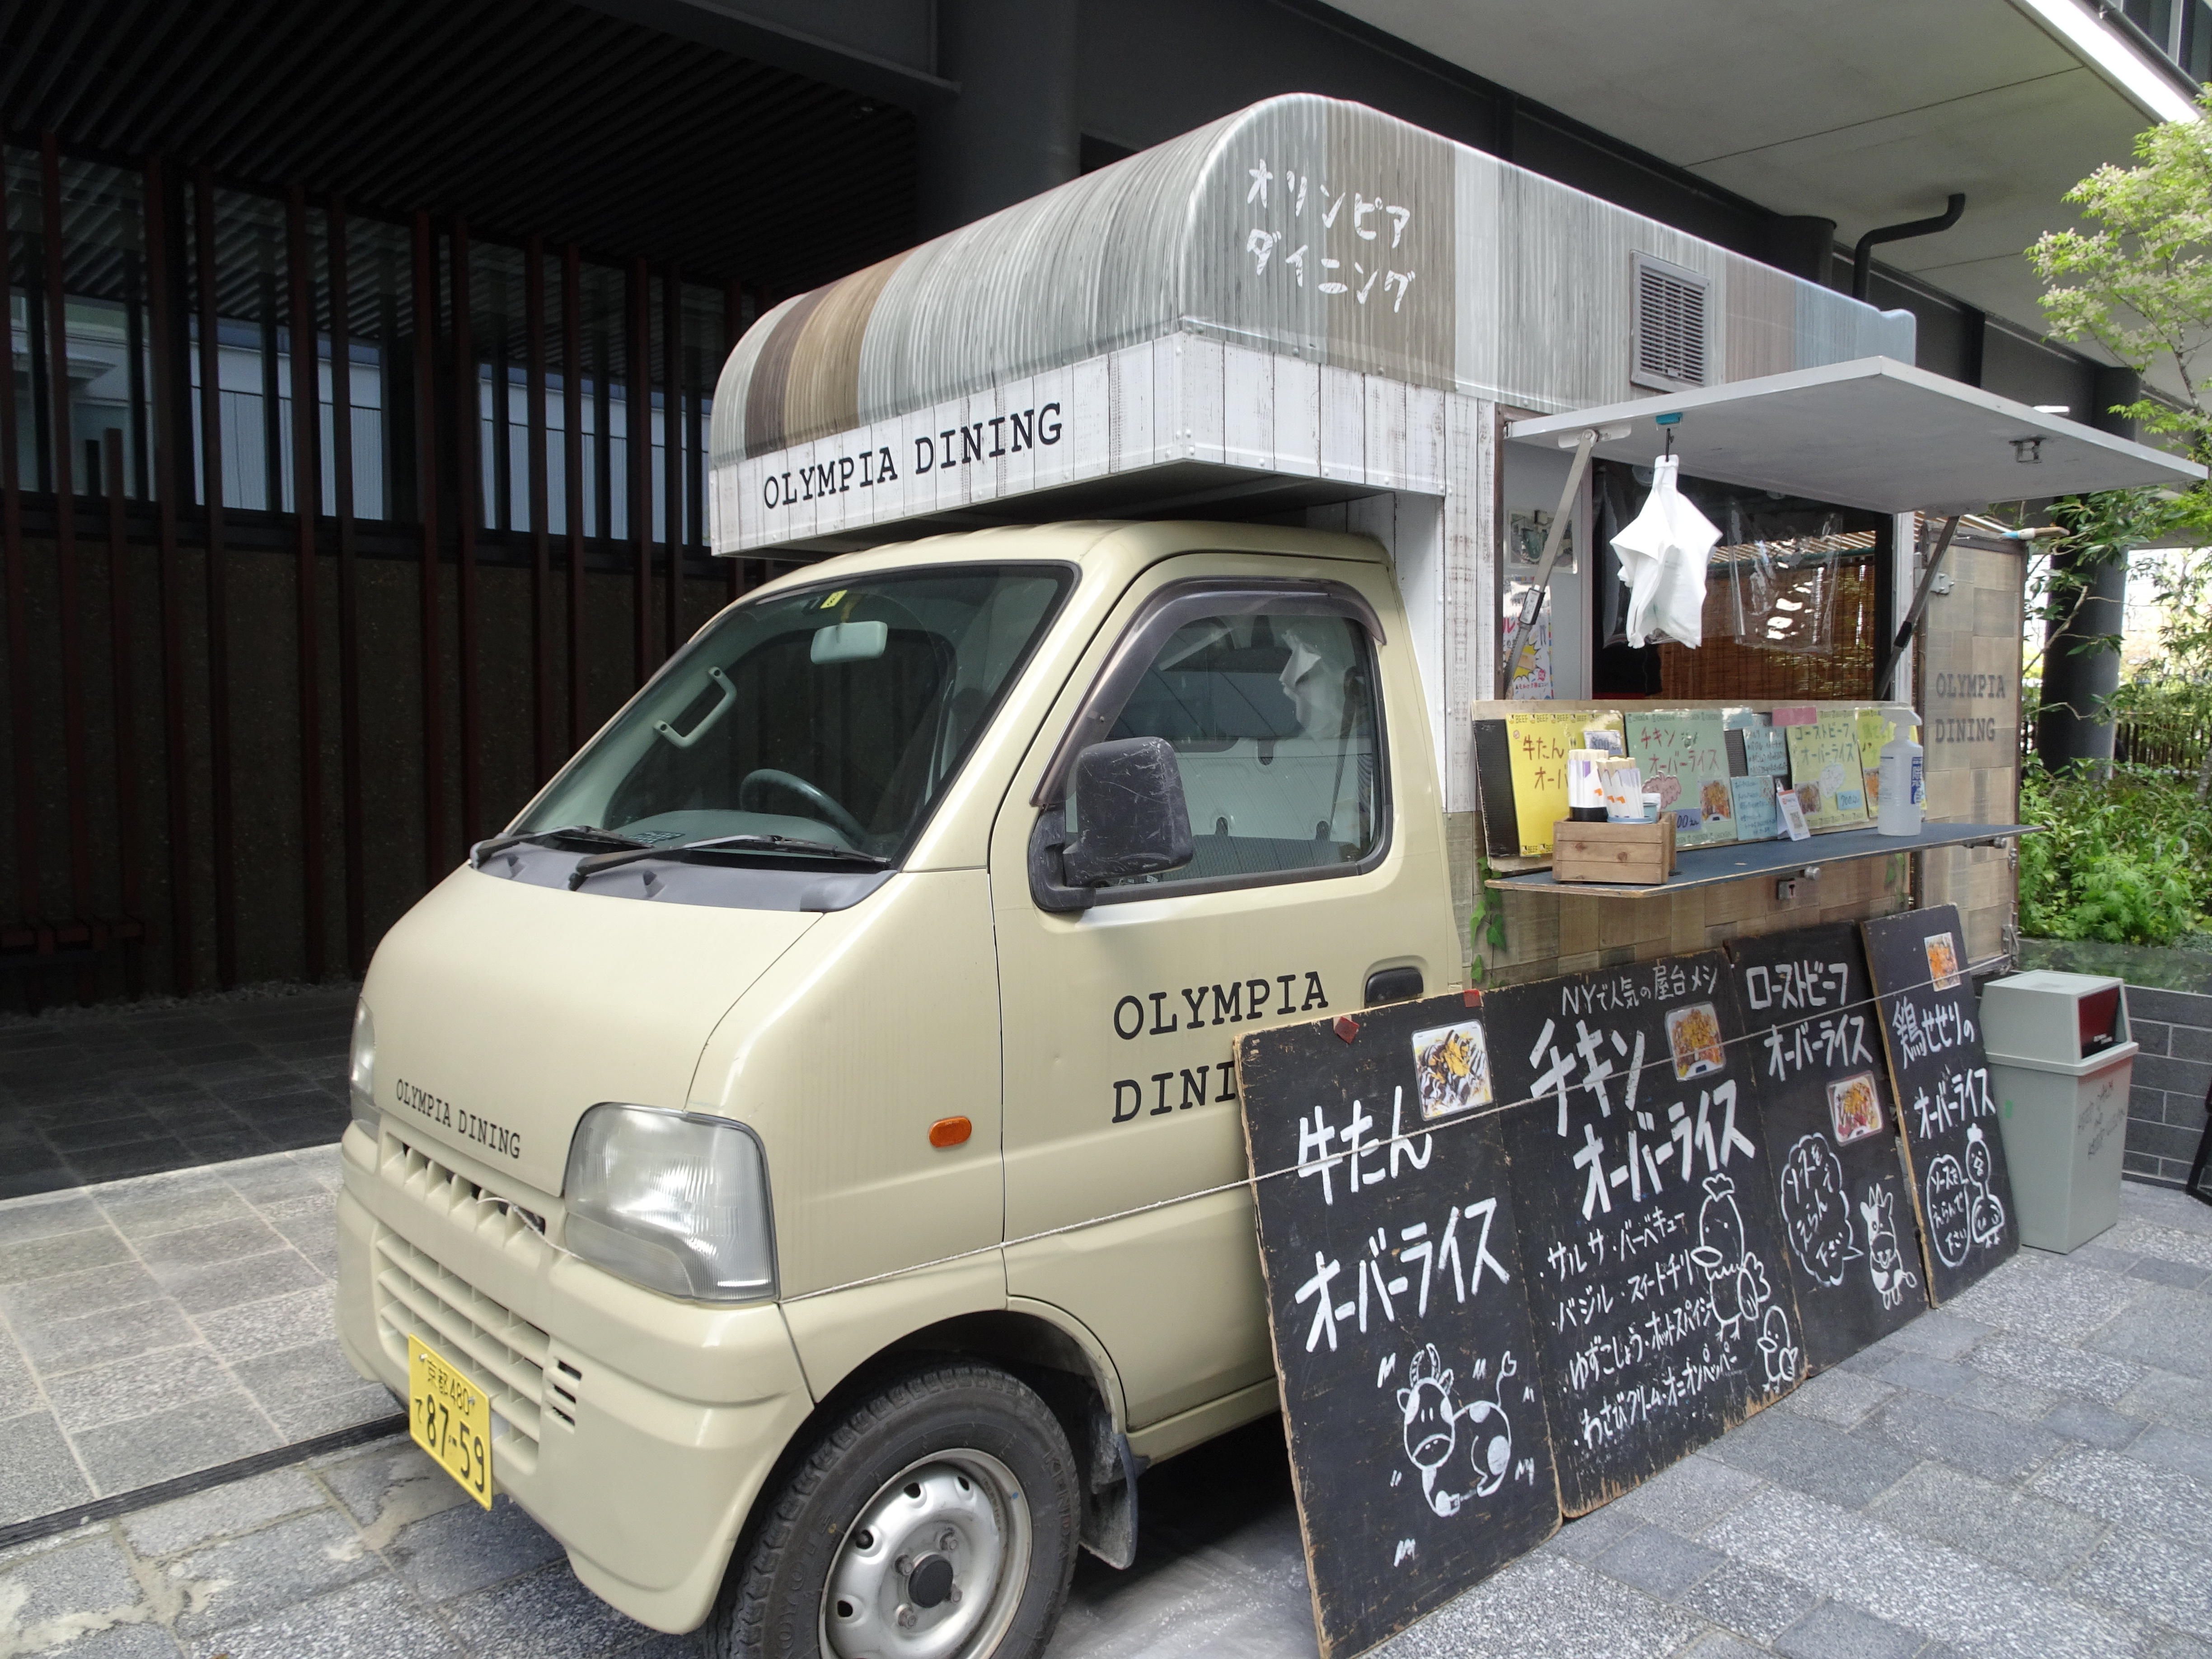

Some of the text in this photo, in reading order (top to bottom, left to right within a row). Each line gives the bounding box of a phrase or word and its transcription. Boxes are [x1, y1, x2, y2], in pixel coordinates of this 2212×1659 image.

[1247, 158, 1410, 248] オリンピア
[1247, 228, 1415, 313] ダイニング
[764, 402, 1063, 509] OLYMPIA DINING
[1936, 673, 2006, 698] OLYMPIA
[1523, 734, 1565, 760] 牛たん
[1649, 749, 1720, 774] オーバーライス
[1935, 717, 1995, 743] DINING
[1114, 971, 1329, 1040] OLYMPIA
[1561, 965, 1718, 1016] NYで人気の屋台メシ
[1746, 960, 1848, 1010] ローストビーフ
[1763, 1014, 1873, 1082] オーバーライス
[1892, 995, 1975, 1069] 鶏せせりの
[396, 1078, 520, 1159] OLYMPIA DINING
[1914, 1068, 1996, 1139] オーバーライス
[1298, 1085, 1433, 1206] 牛たん
[1573, 1079, 1756, 1221] オーバーライス
[1932, 1190, 1965, 1229] えらんで
[1945, 1227, 1968, 1256] 下さい
[1294, 1197, 1510, 1352] オーバーライス
[450, 1377, 470, 1416] 480
[426, 1393, 485, 1494] 87-59
